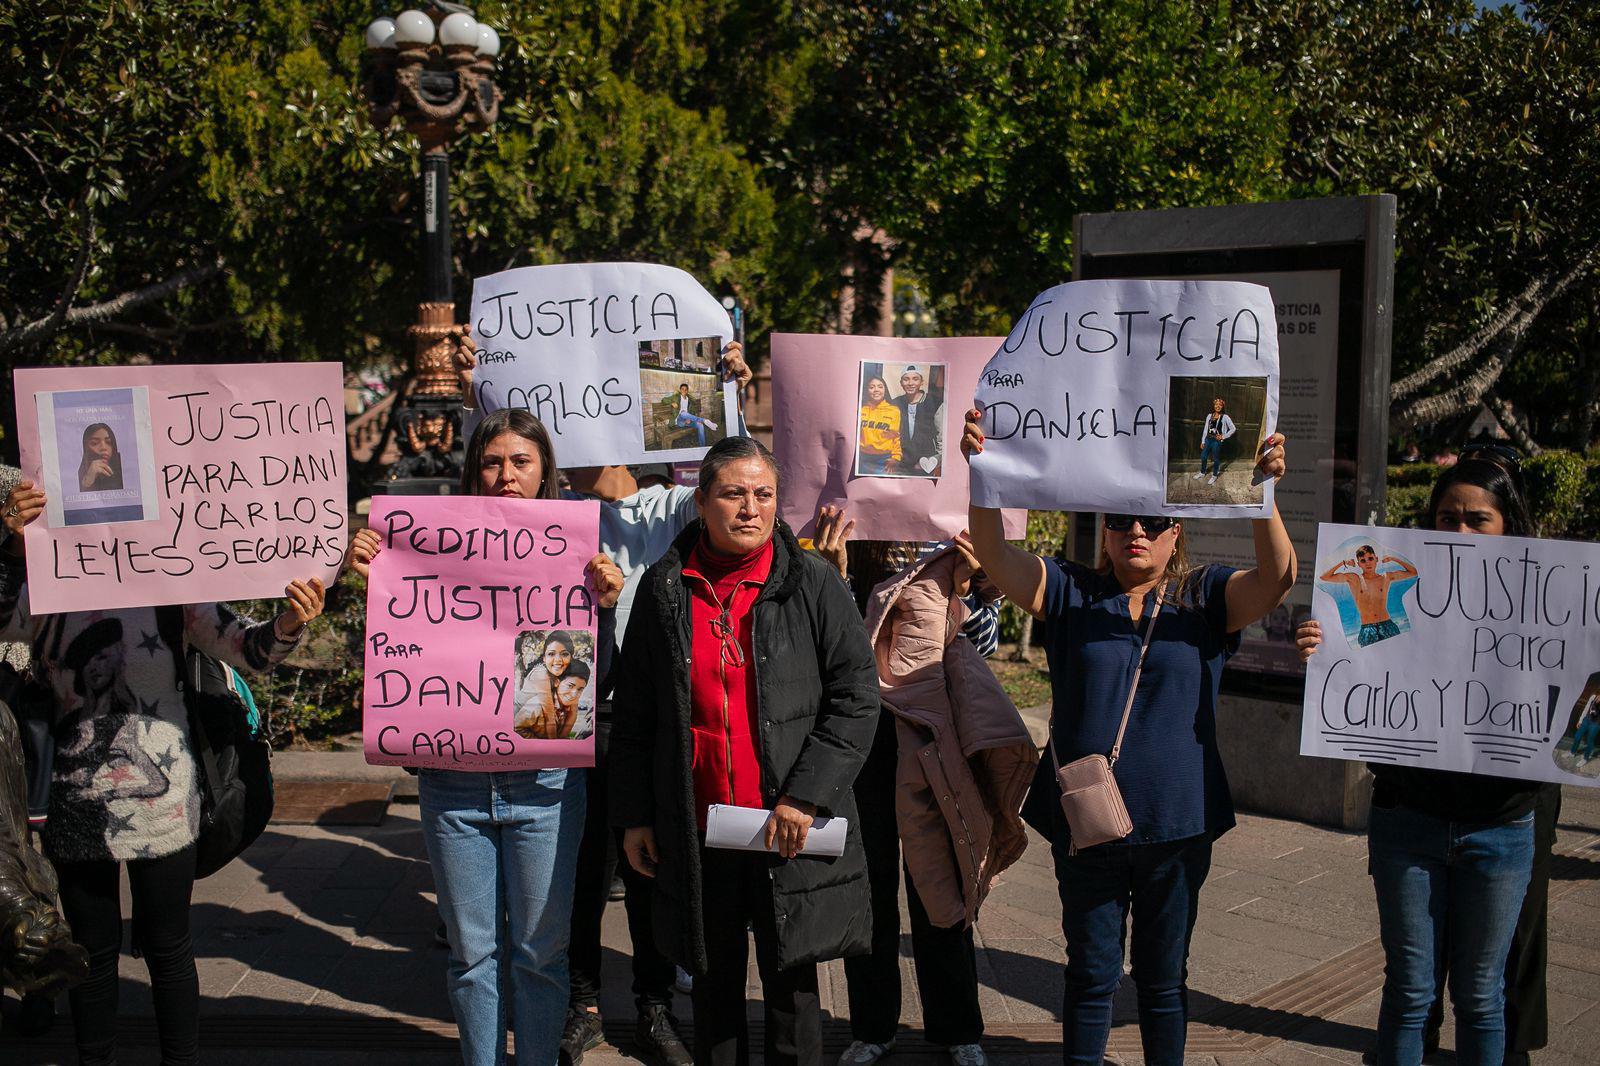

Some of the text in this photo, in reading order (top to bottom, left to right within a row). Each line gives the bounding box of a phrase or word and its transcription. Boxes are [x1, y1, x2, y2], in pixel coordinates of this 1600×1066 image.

[477, 291, 679, 340] JUSTICIA
[1003, 300, 1260, 362] JUSTICIA
[1275, 303, 1321, 316] STICIA
[1299, 321, 1317, 335] DE
[476, 349, 517, 366] PARA
[981, 369, 1024, 388] PARA
[167, 391, 335, 446] JUSTICIA
[479, 377, 632, 435] CARLOS
[984, 392, 1157, 441] DANIELA
[163, 450, 338, 499] PARA DANI
[54, 534, 344, 583] LEYES SEGURAS
[384, 510, 568, 562] PEDIMOS
[388, 574, 593, 630] JUSTICIA
[1416, 541, 1600, 627] Justici
[369, 632, 423, 659] PARA
[371, 660, 509, 715] DANY
[1321, 659, 1561, 743] Carlos Y Dani!
[378, 726, 515, 762] CARLOS
